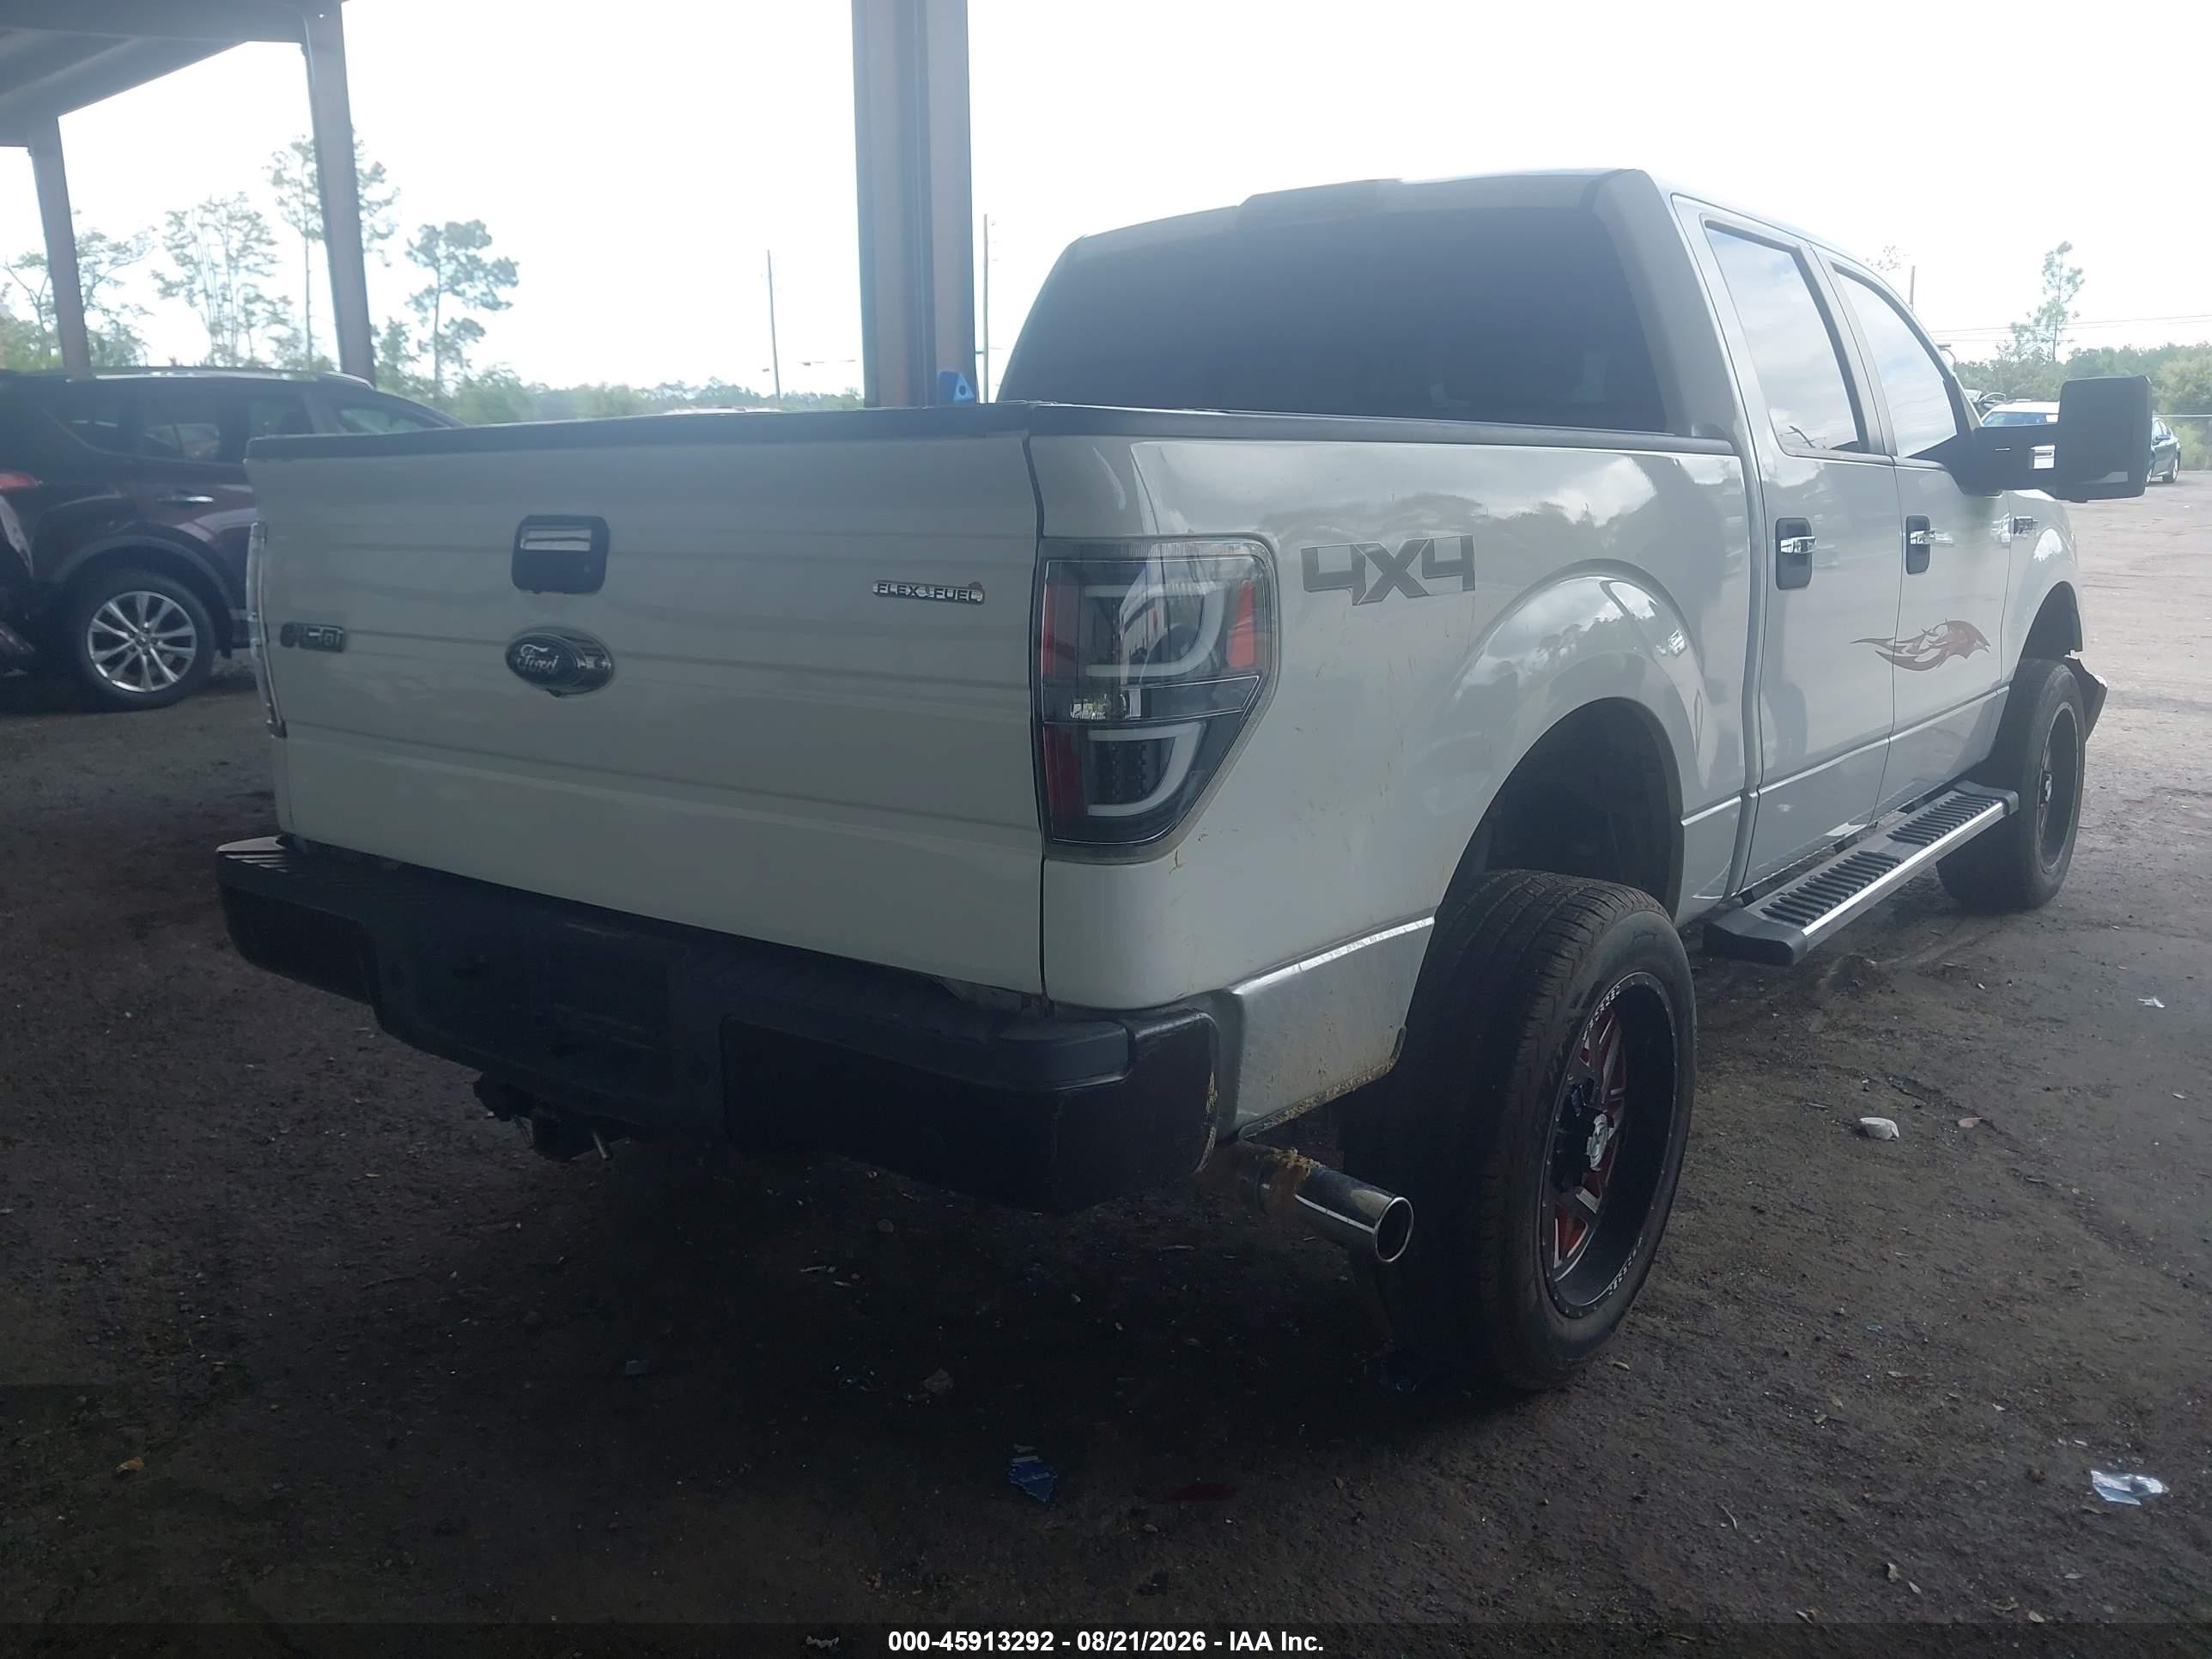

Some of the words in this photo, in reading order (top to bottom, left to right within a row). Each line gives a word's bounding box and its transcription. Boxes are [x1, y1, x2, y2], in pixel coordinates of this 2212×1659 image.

[1301, 534, 1476, 605] 4X4
[877, 582, 920, 598] FLEX
[933, 587, 981, 603] FUEL
[517, 643, 560, 674] Ford
